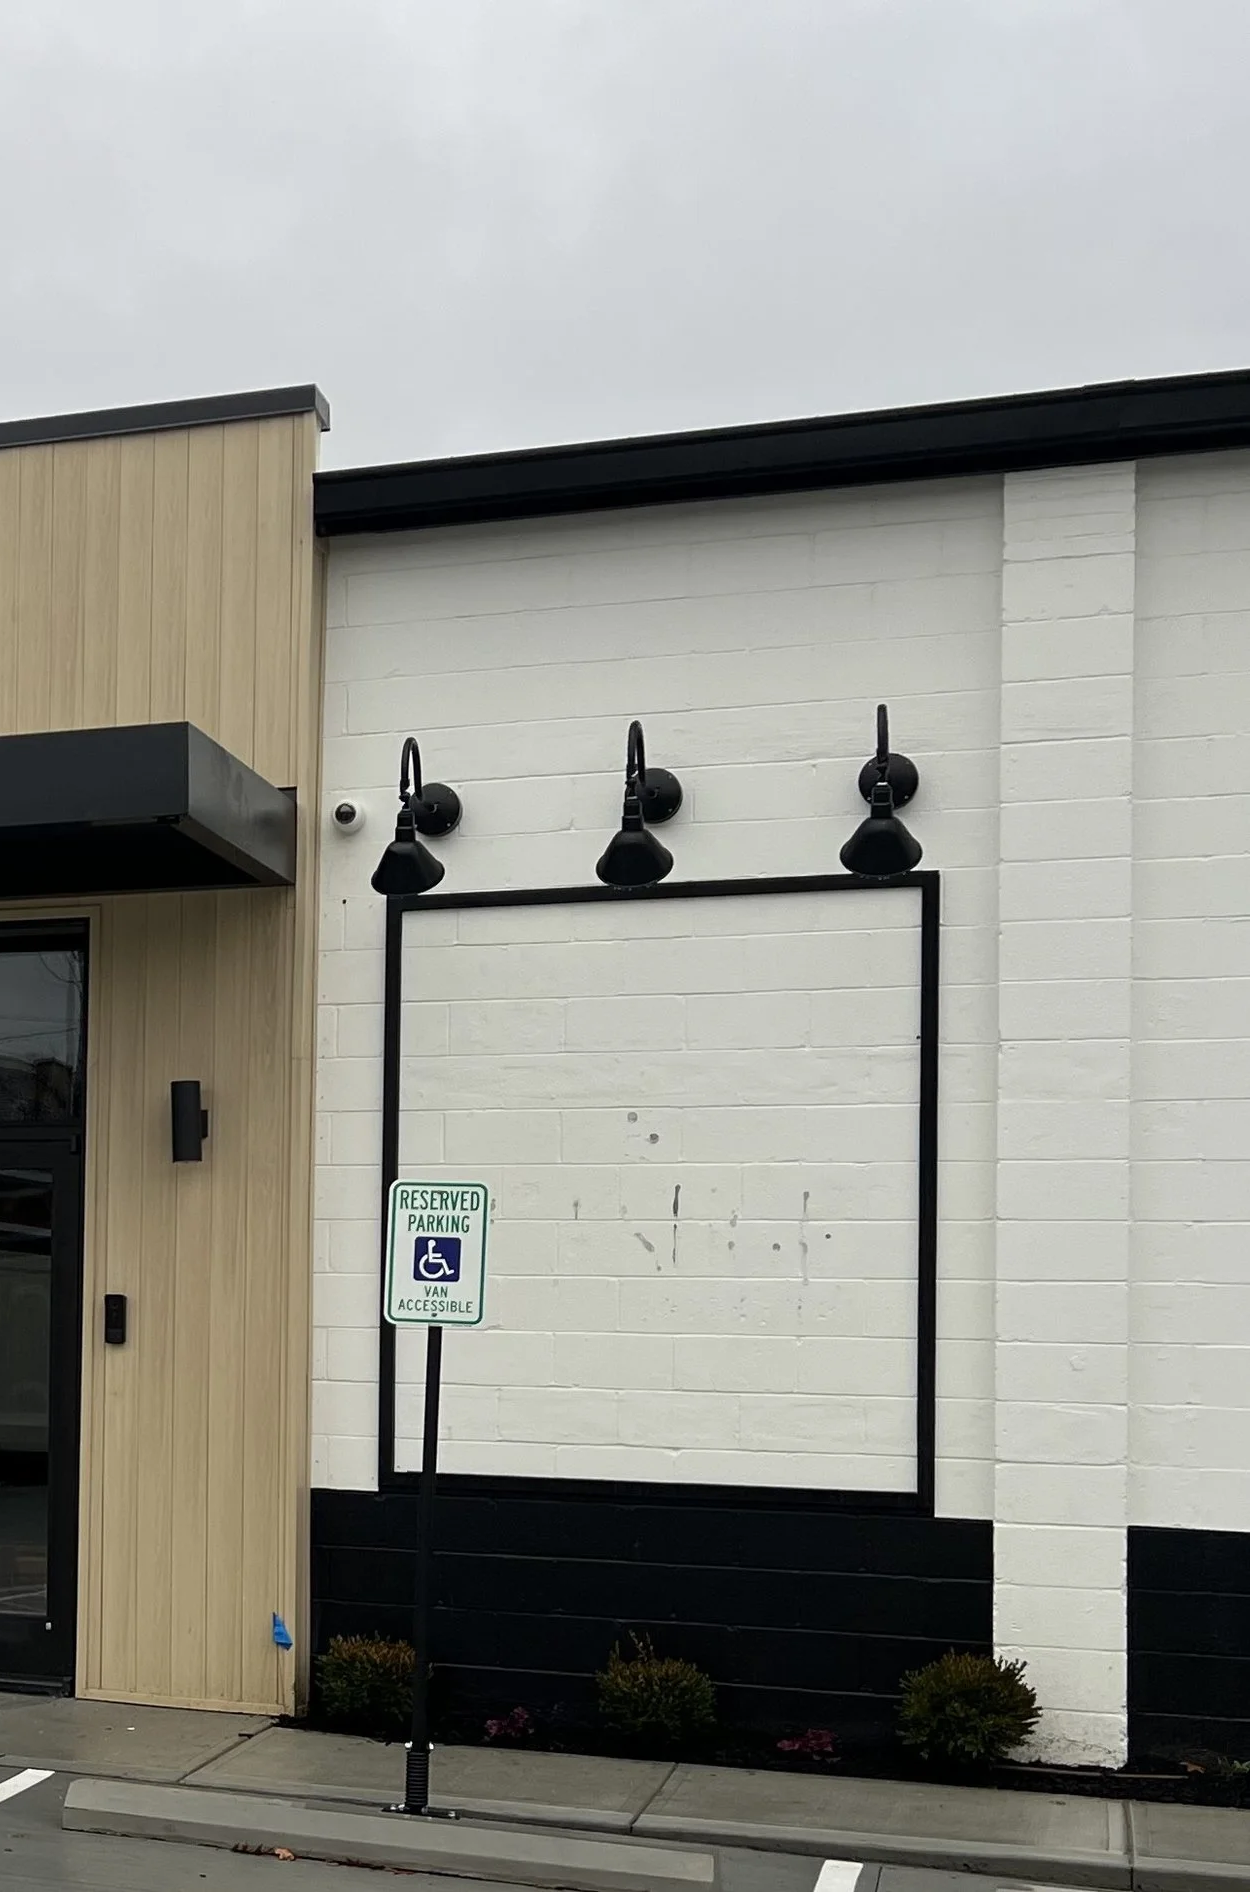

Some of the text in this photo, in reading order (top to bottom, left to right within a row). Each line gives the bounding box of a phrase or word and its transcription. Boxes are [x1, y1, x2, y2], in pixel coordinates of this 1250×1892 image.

[400, 1189, 480, 1211] RESERVED
[407, 1214, 470, 1233] PARKING
[424, 1285, 448, 1298] VAN
[398, 1299, 473, 1313] ACCESSIBLE
